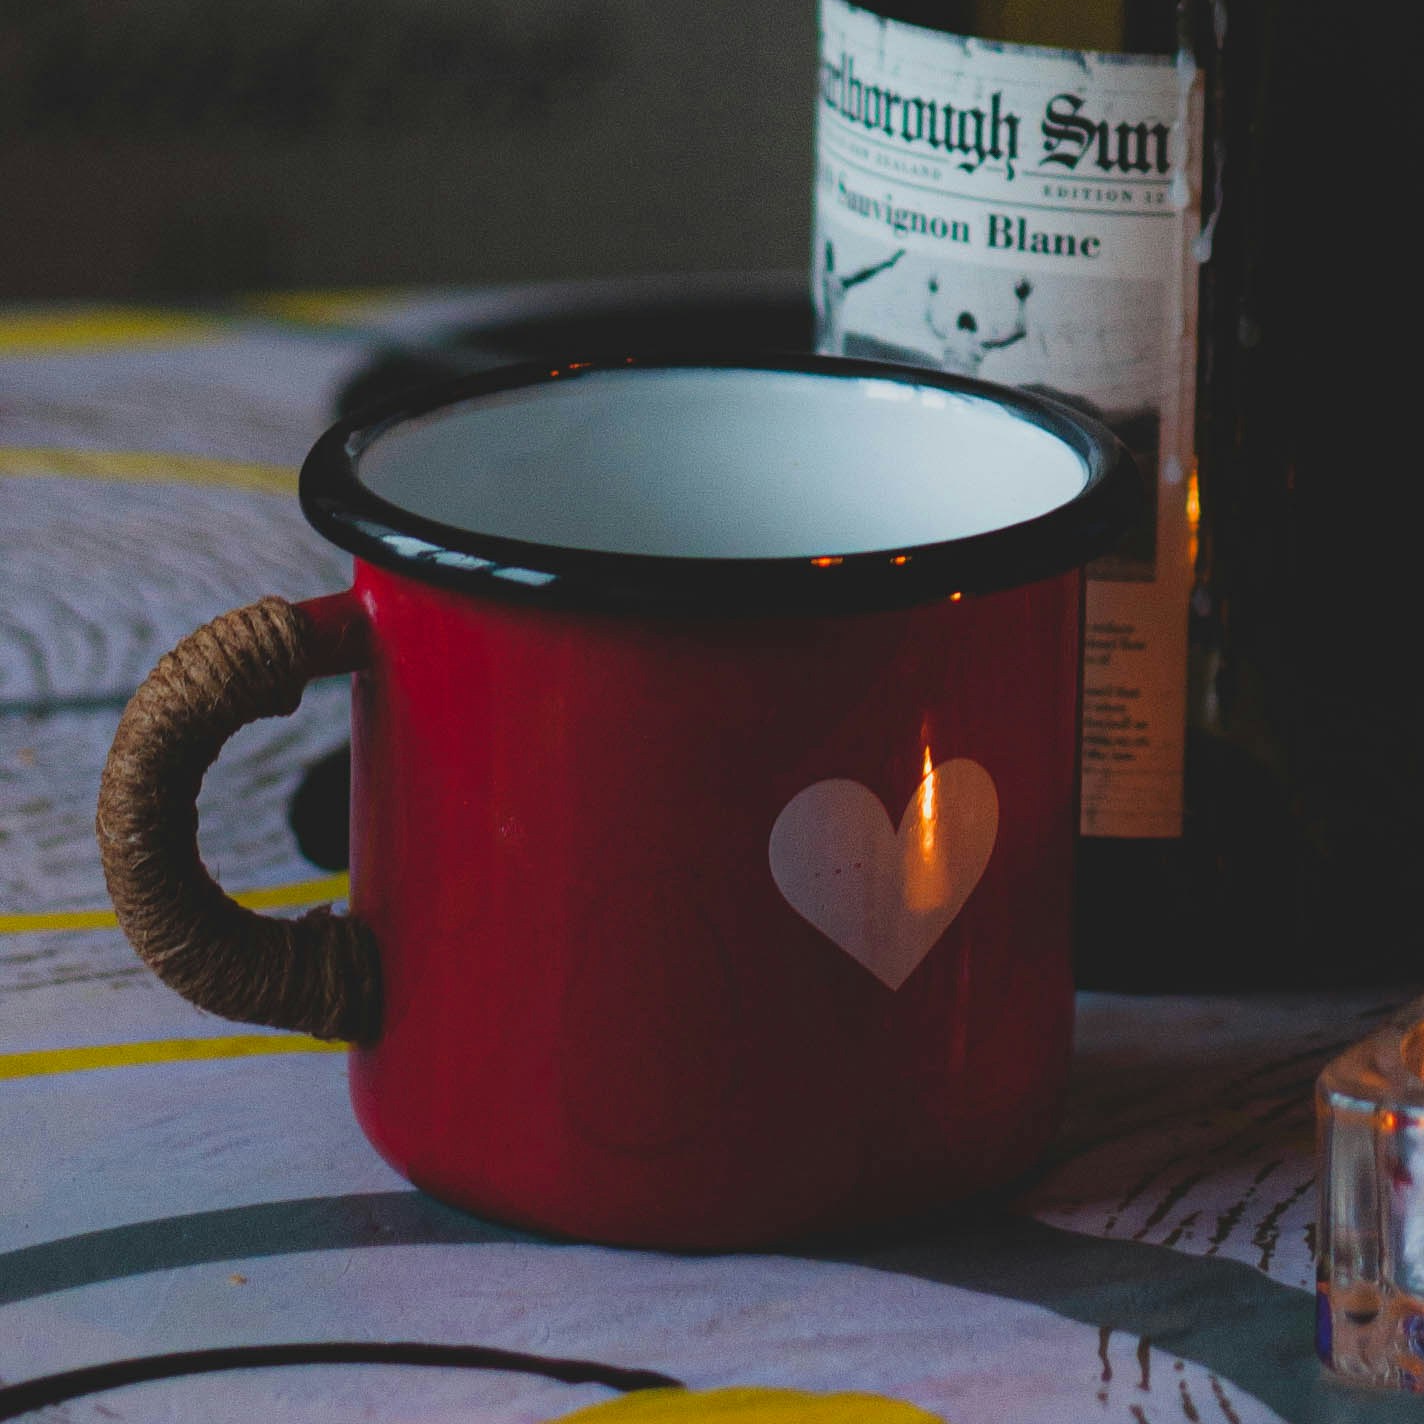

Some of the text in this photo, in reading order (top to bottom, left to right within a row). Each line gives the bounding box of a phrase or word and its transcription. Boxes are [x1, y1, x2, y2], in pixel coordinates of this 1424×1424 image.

[1041, 92, 1171, 174] Sun
[837, 171, 971, 244] Sauvignon
[987, 214, 1102, 258] Blanc
[1043, 184, 1134, 202] EDITION
